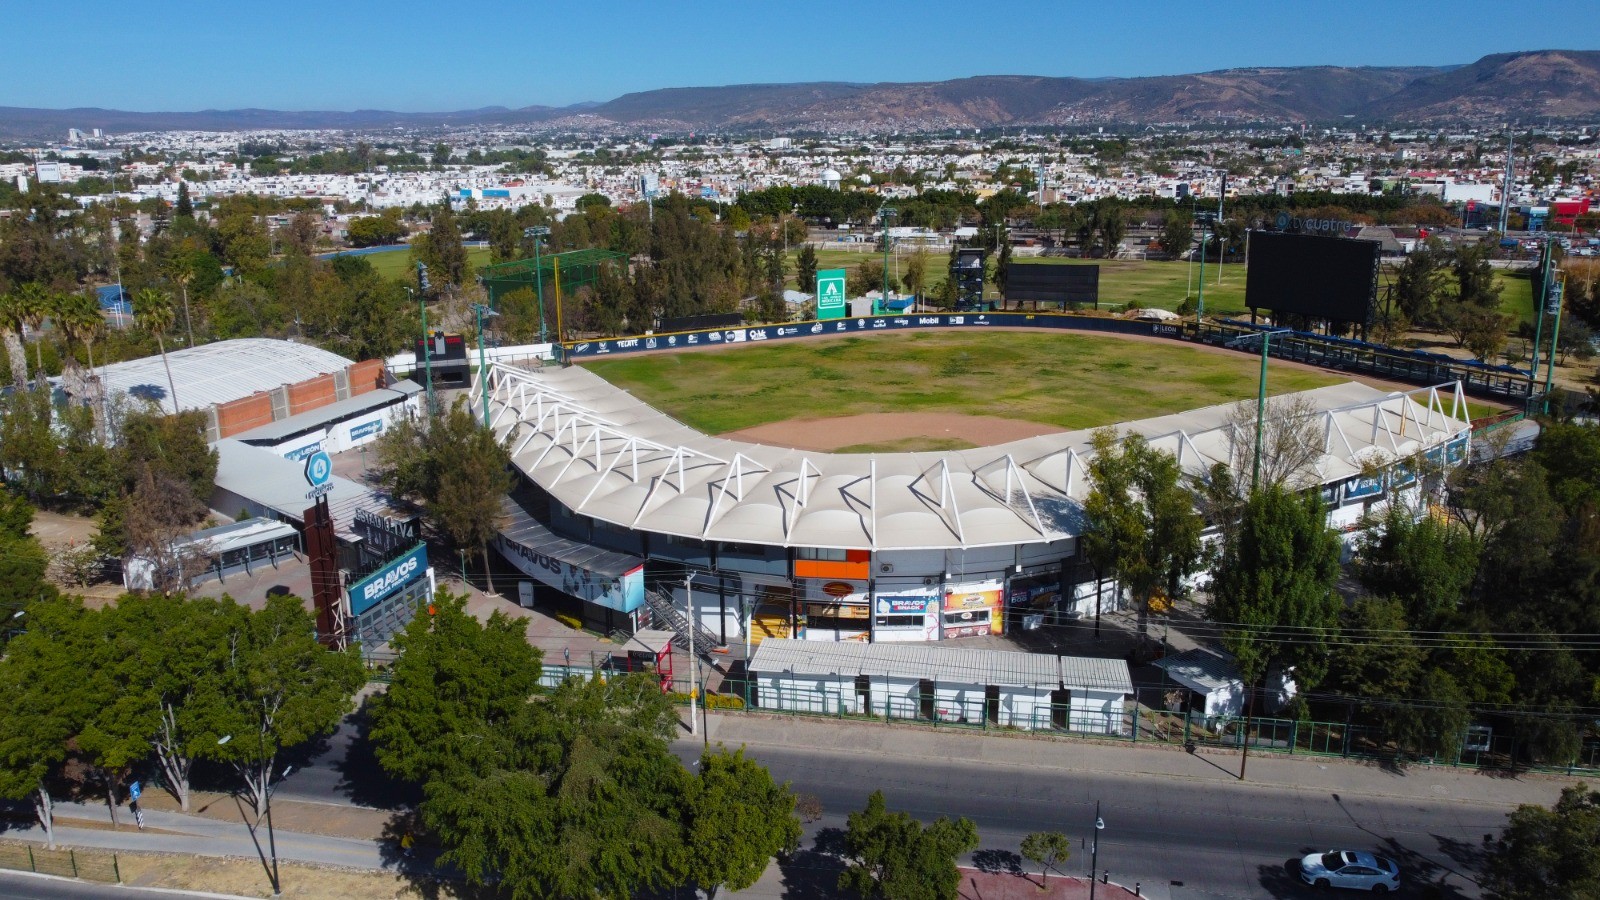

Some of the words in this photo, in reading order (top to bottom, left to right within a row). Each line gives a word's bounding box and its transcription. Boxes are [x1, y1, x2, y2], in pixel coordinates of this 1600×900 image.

[617, 339, 638, 348] TECATE
[355, 507, 392, 532] ESTADIO
[364, 557, 418, 600] BRAVOS
